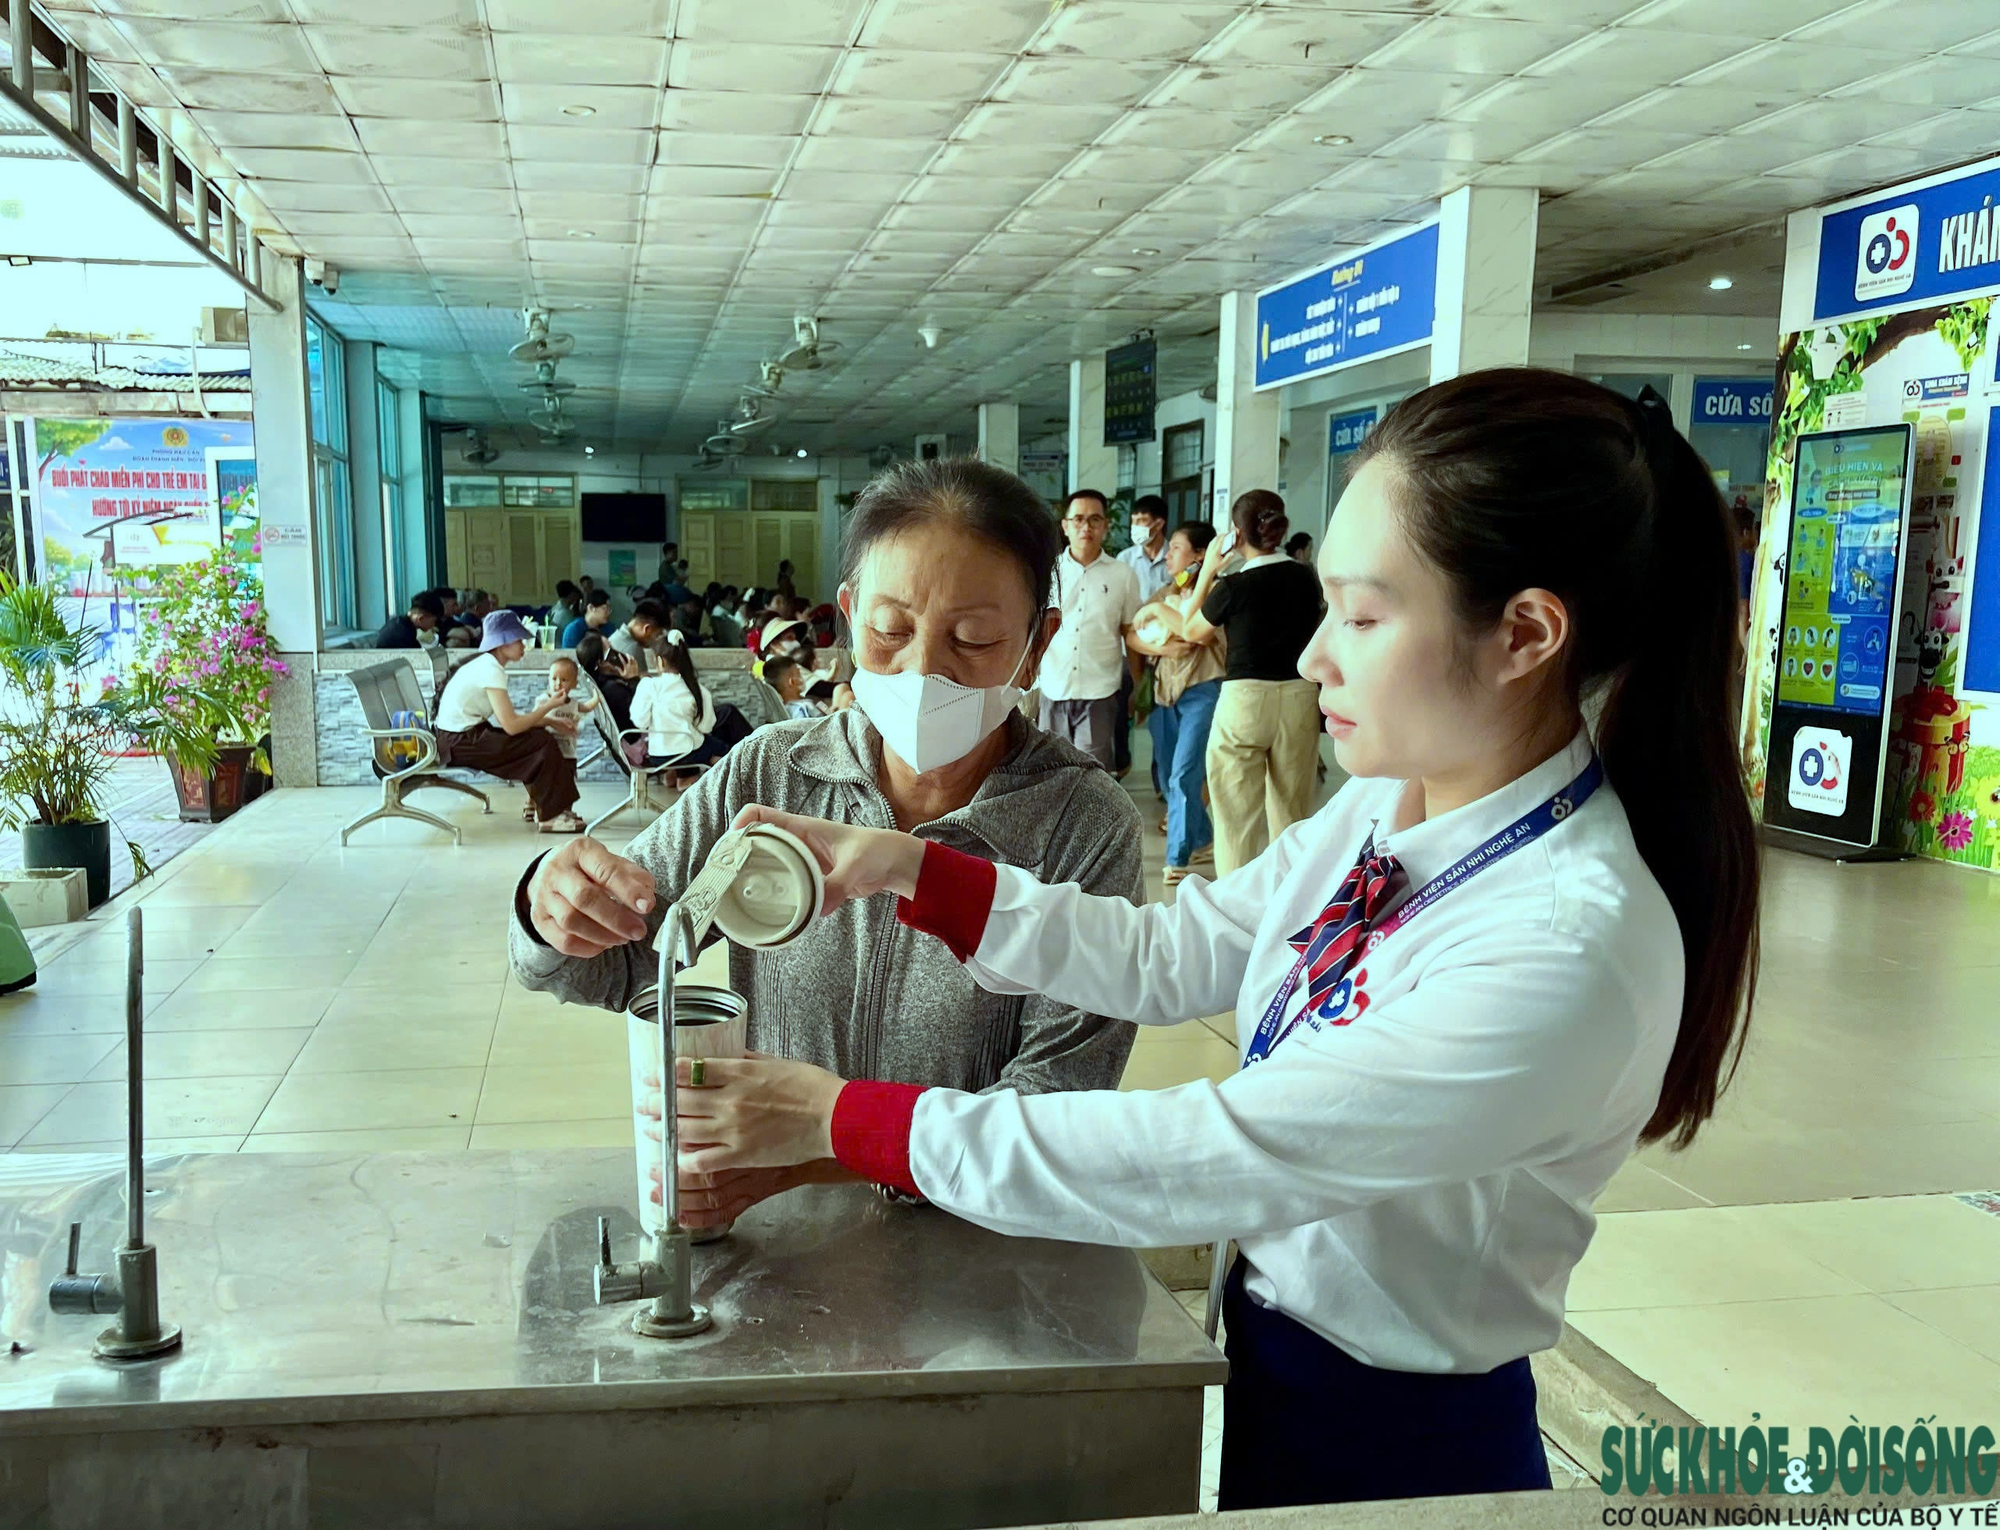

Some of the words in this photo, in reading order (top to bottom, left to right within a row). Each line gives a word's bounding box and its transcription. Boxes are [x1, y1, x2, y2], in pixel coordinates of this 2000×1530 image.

[1705, 387, 1743, 416] CỬA
[177, 471, 188, 489] EM
[1422, 879, 1445, 898] VIỆN
[1445, 865, 1467, 883] SẢN
[1466, 853, 1486, 868] NHI
[1485, 832, 1515, 857] NGHỆ
[1515, 822, 1531, 838] AN
